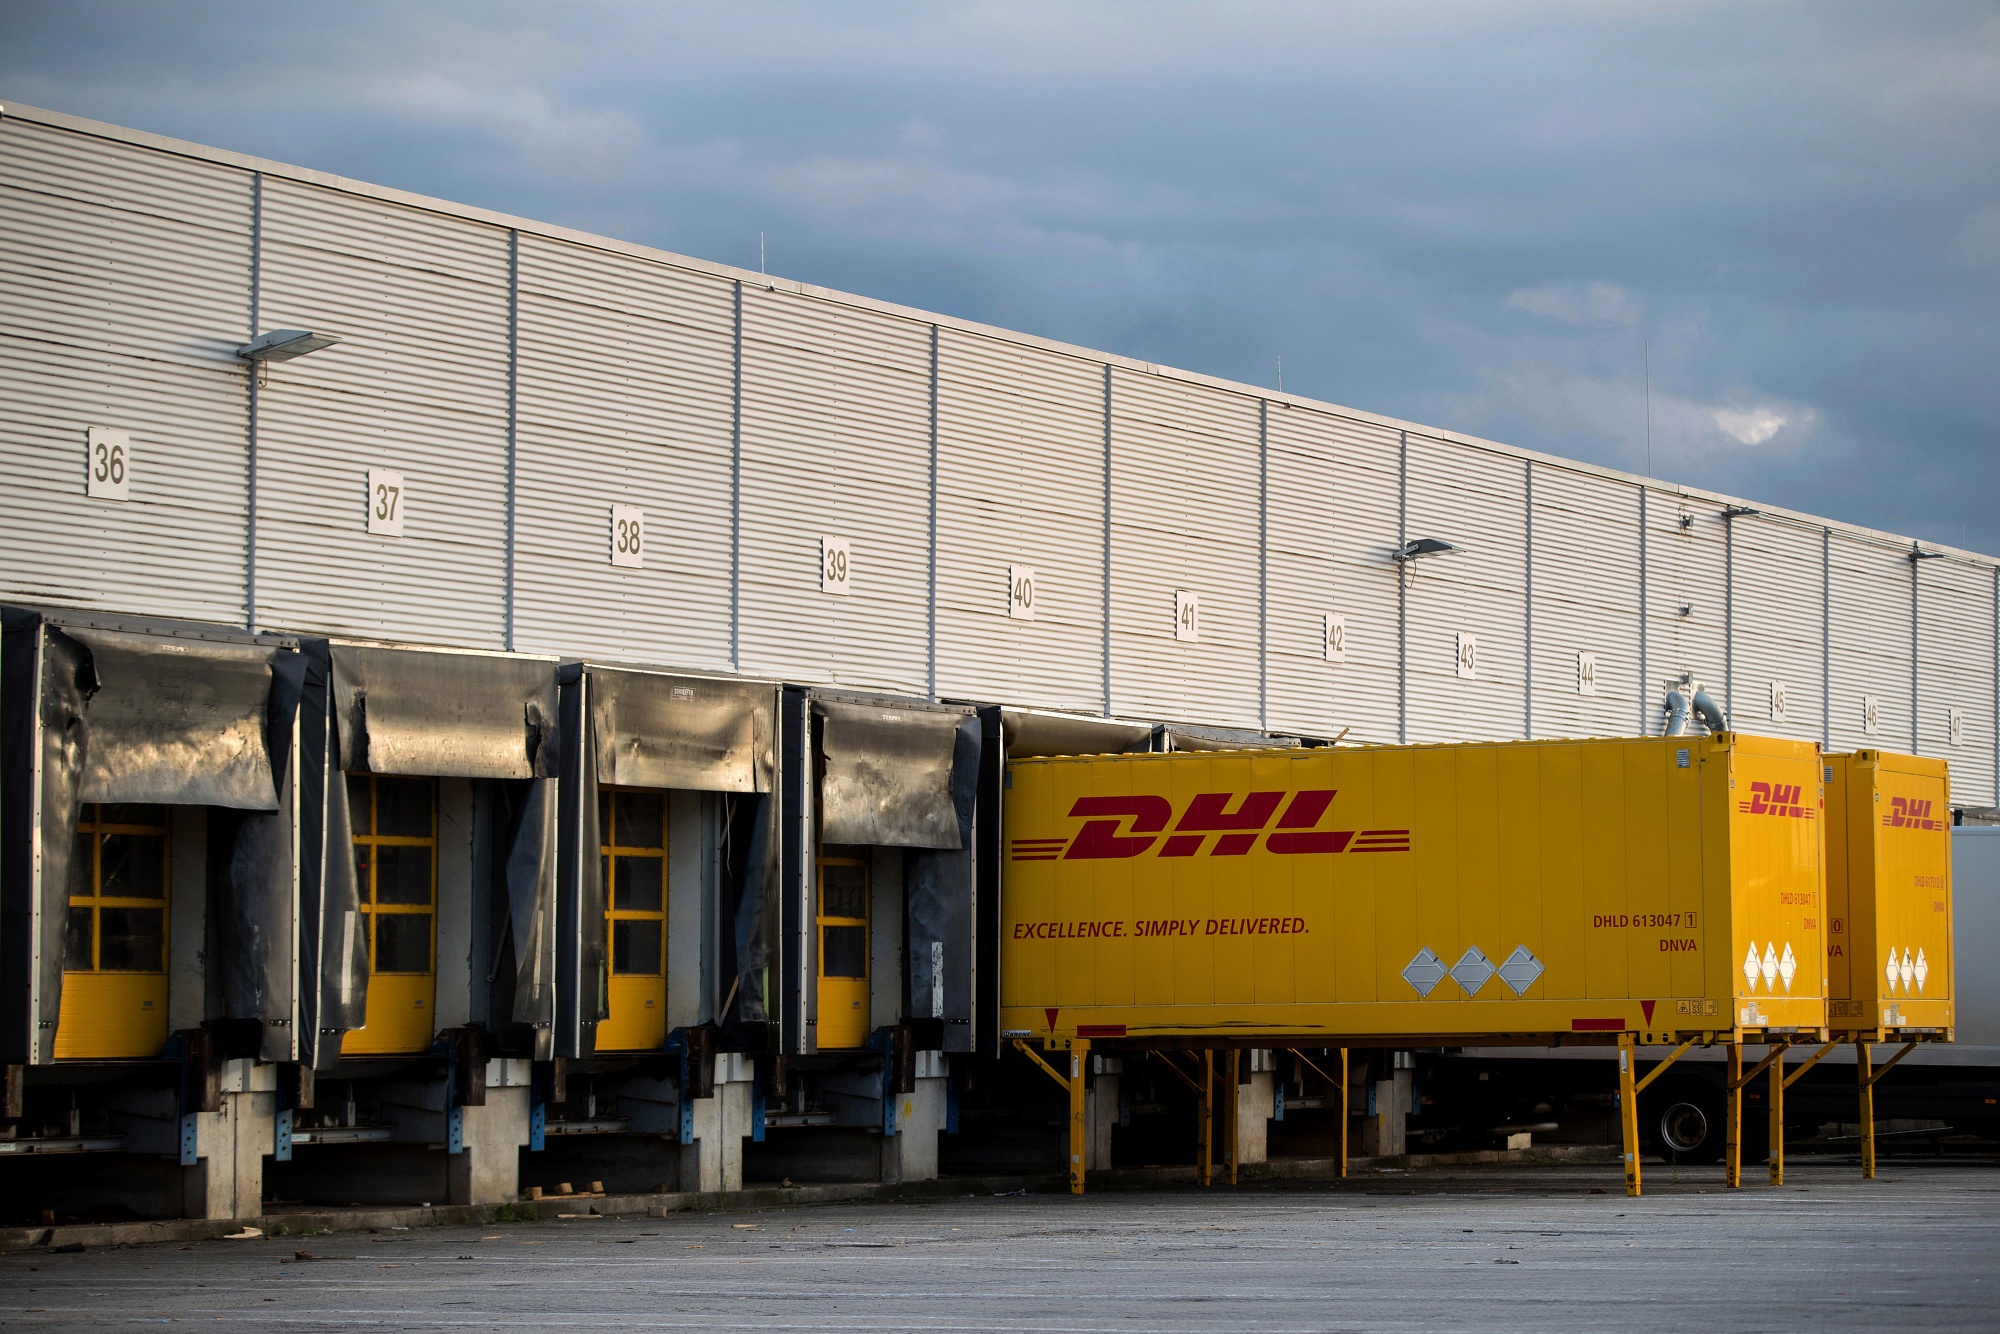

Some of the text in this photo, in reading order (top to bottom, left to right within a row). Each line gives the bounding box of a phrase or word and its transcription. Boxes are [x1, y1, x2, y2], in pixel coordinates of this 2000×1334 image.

[95, 443, 124, 484] 36
[376, 484, 399, 521] 37
[617, 519, 640, 554] 38
[826, 549, 847, 582] 39
[1014, 578, 1032, 608] 40
[1181, 603, 1194, 630] 41
[1329, 625, 1342, 651] 42
[1461, 644, 1473, 670] 43
[1582, 663, 1594, 686] 44
[1774, 691, 1784, 713] 45
[1867, 705, 1876, 727] 46
[1952, 717, 1961, 737] 47
[1750, 782, 1804, 818] DHL
[1062, 790, 1356, 859] DHL
[1891, 797, 1935, 830] DHL
[1781, 892, 1793, 905] DHLD
[1795, 893, 1810, 905] 613047
[1013, 917, 1311, 939] EXCELLENCE. SIMPLY DELIVERED.
[1593, 915, 1629, 928] DHLD
[1633, 914, 1681, 927] 613047
[1804, 918, 1817, 930] DNVA
[1660, 939, 1698, 952] DNVA
[1827, 945, 1843, 957] VA
